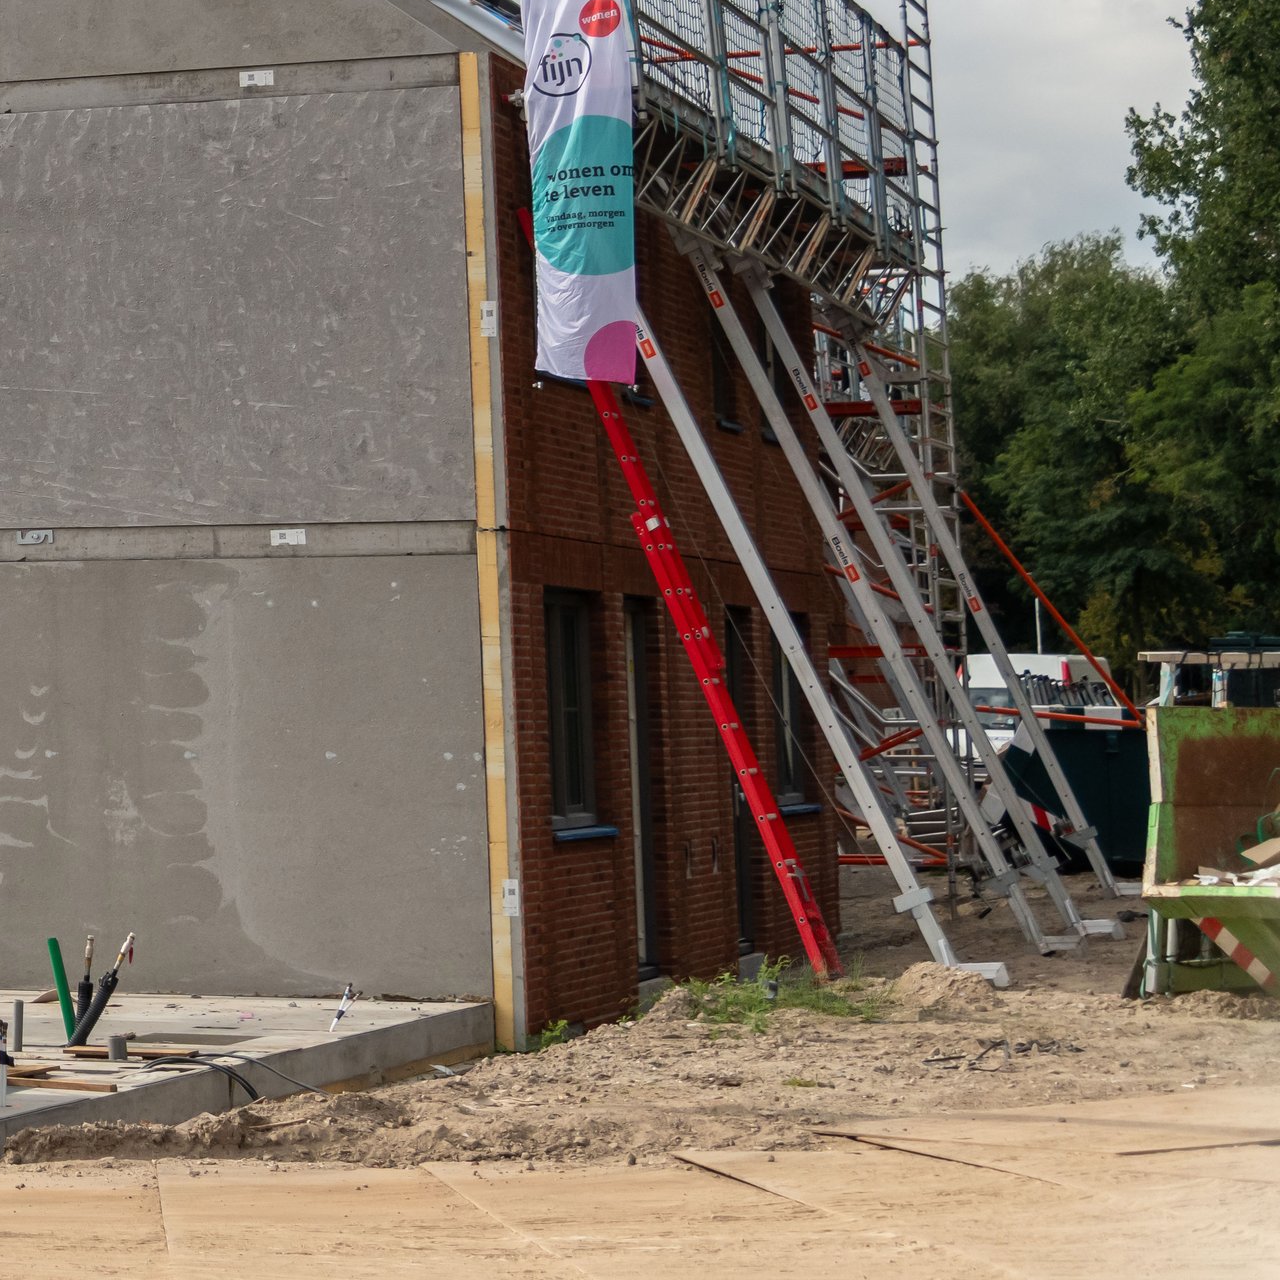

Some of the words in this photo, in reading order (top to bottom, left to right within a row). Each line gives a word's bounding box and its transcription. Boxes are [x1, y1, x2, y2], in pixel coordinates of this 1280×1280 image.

[581, 9, 618, 24] wonen
[540, 55, 583, 86] fijn
[564, 185, 615, 199] leven
[588, 210, 625, 218] morgen
[557, 221, 615, 230] overmorgen
[831, 536, 849, 565] Boels
